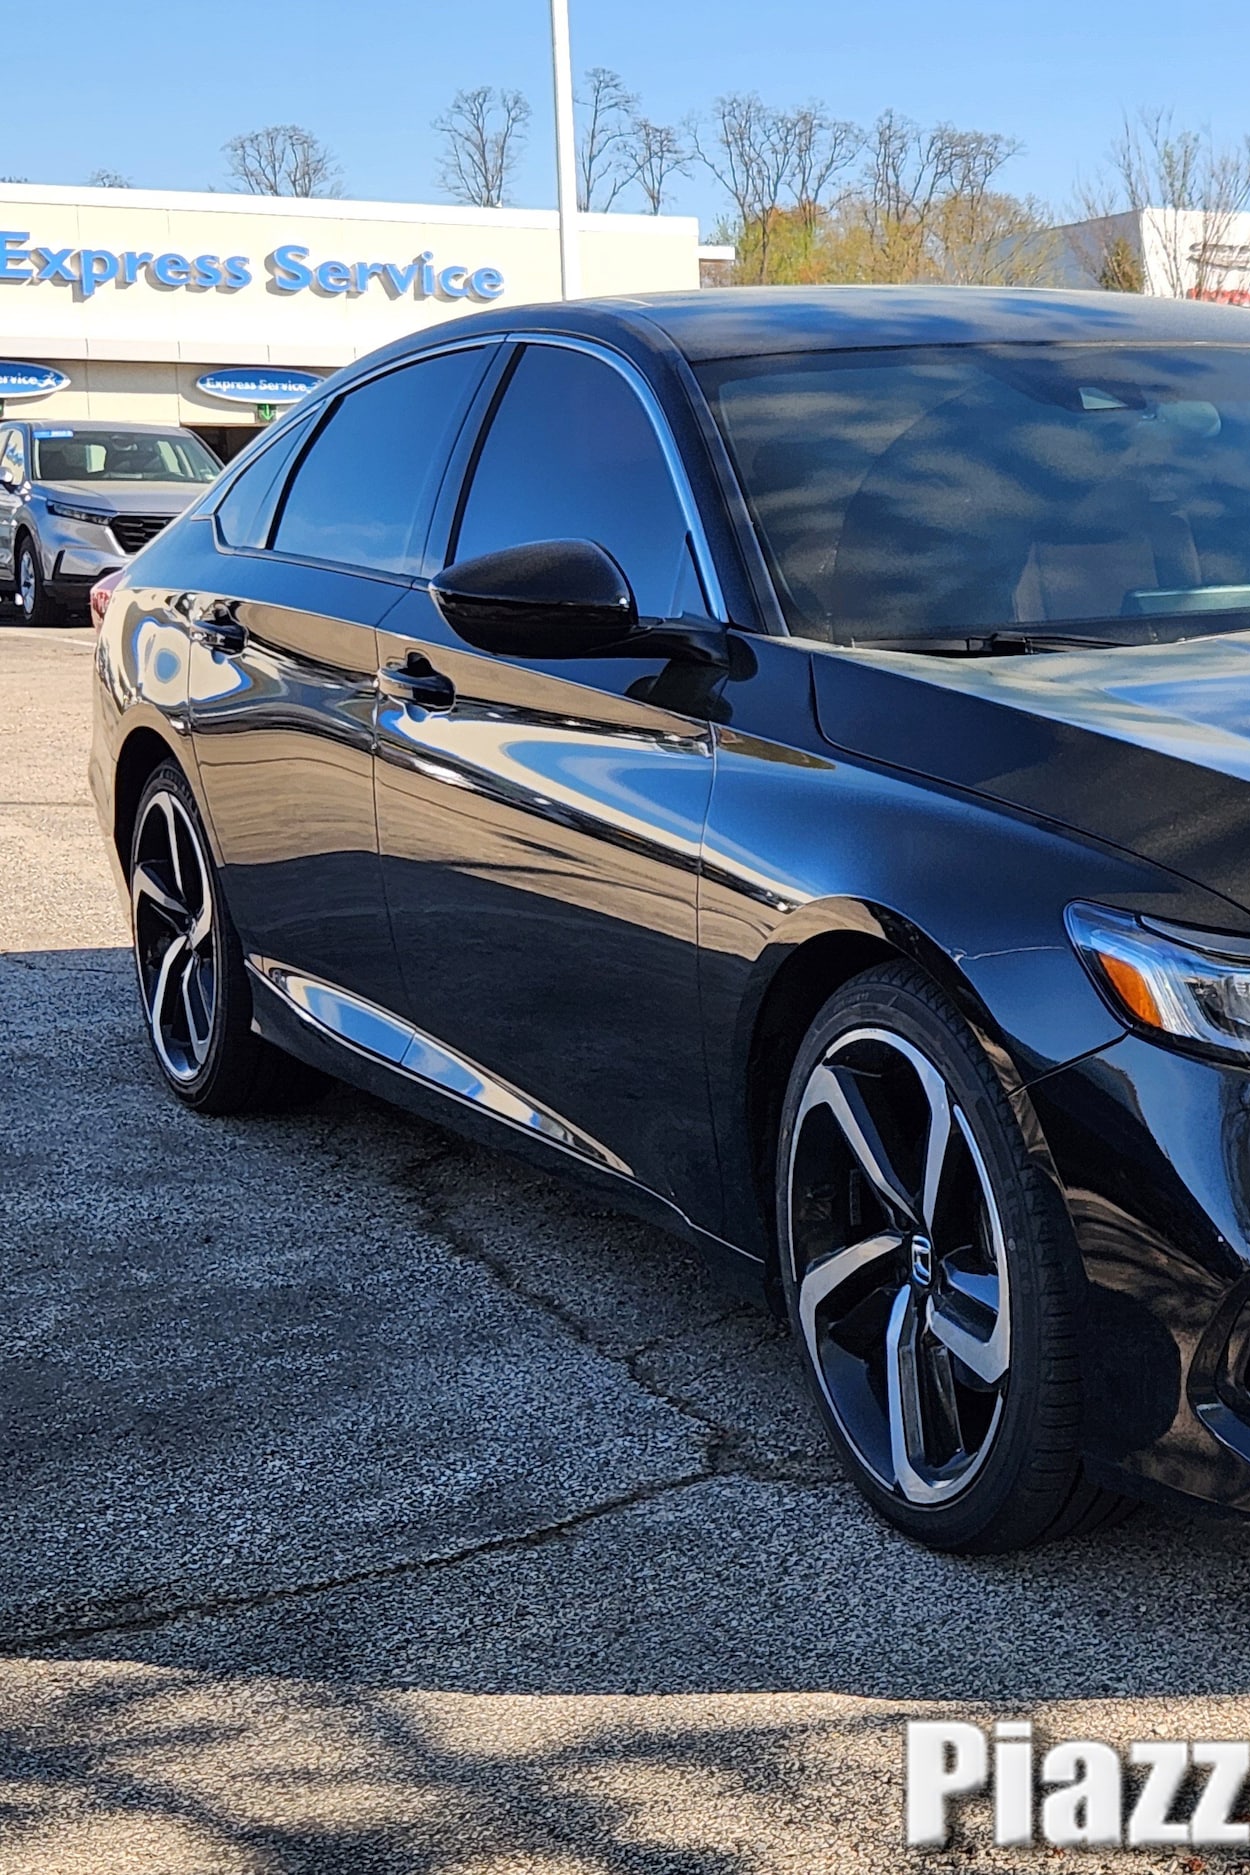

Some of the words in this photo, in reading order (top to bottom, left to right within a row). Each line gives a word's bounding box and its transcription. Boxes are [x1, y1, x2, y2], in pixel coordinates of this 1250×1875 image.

[0, 231, 253, 298] Express
[270, 244, 505, 302] Service
[206, 378, 257, 392] Express
[259, 379, 307, 393] Service
